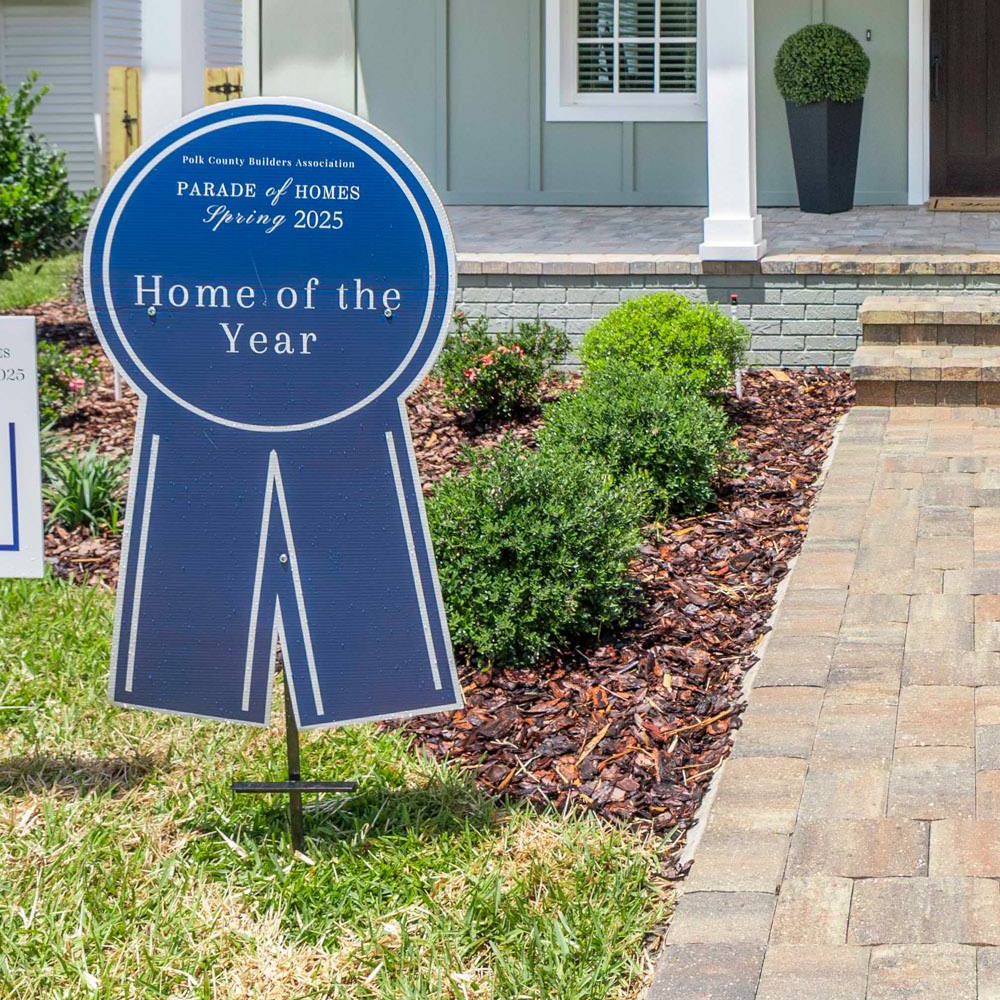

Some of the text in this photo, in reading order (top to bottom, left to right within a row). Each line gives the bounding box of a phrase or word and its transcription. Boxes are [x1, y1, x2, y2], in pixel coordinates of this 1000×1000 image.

[182, 155, 355, 168] Polk County Builders Association
[176, 177, 361, 207] PARADE of HOMES
[202, 204, 344, 234] Spring 2025
[134, 274, 401, 311] Home of the
[218, 322, 318, 355] Year
